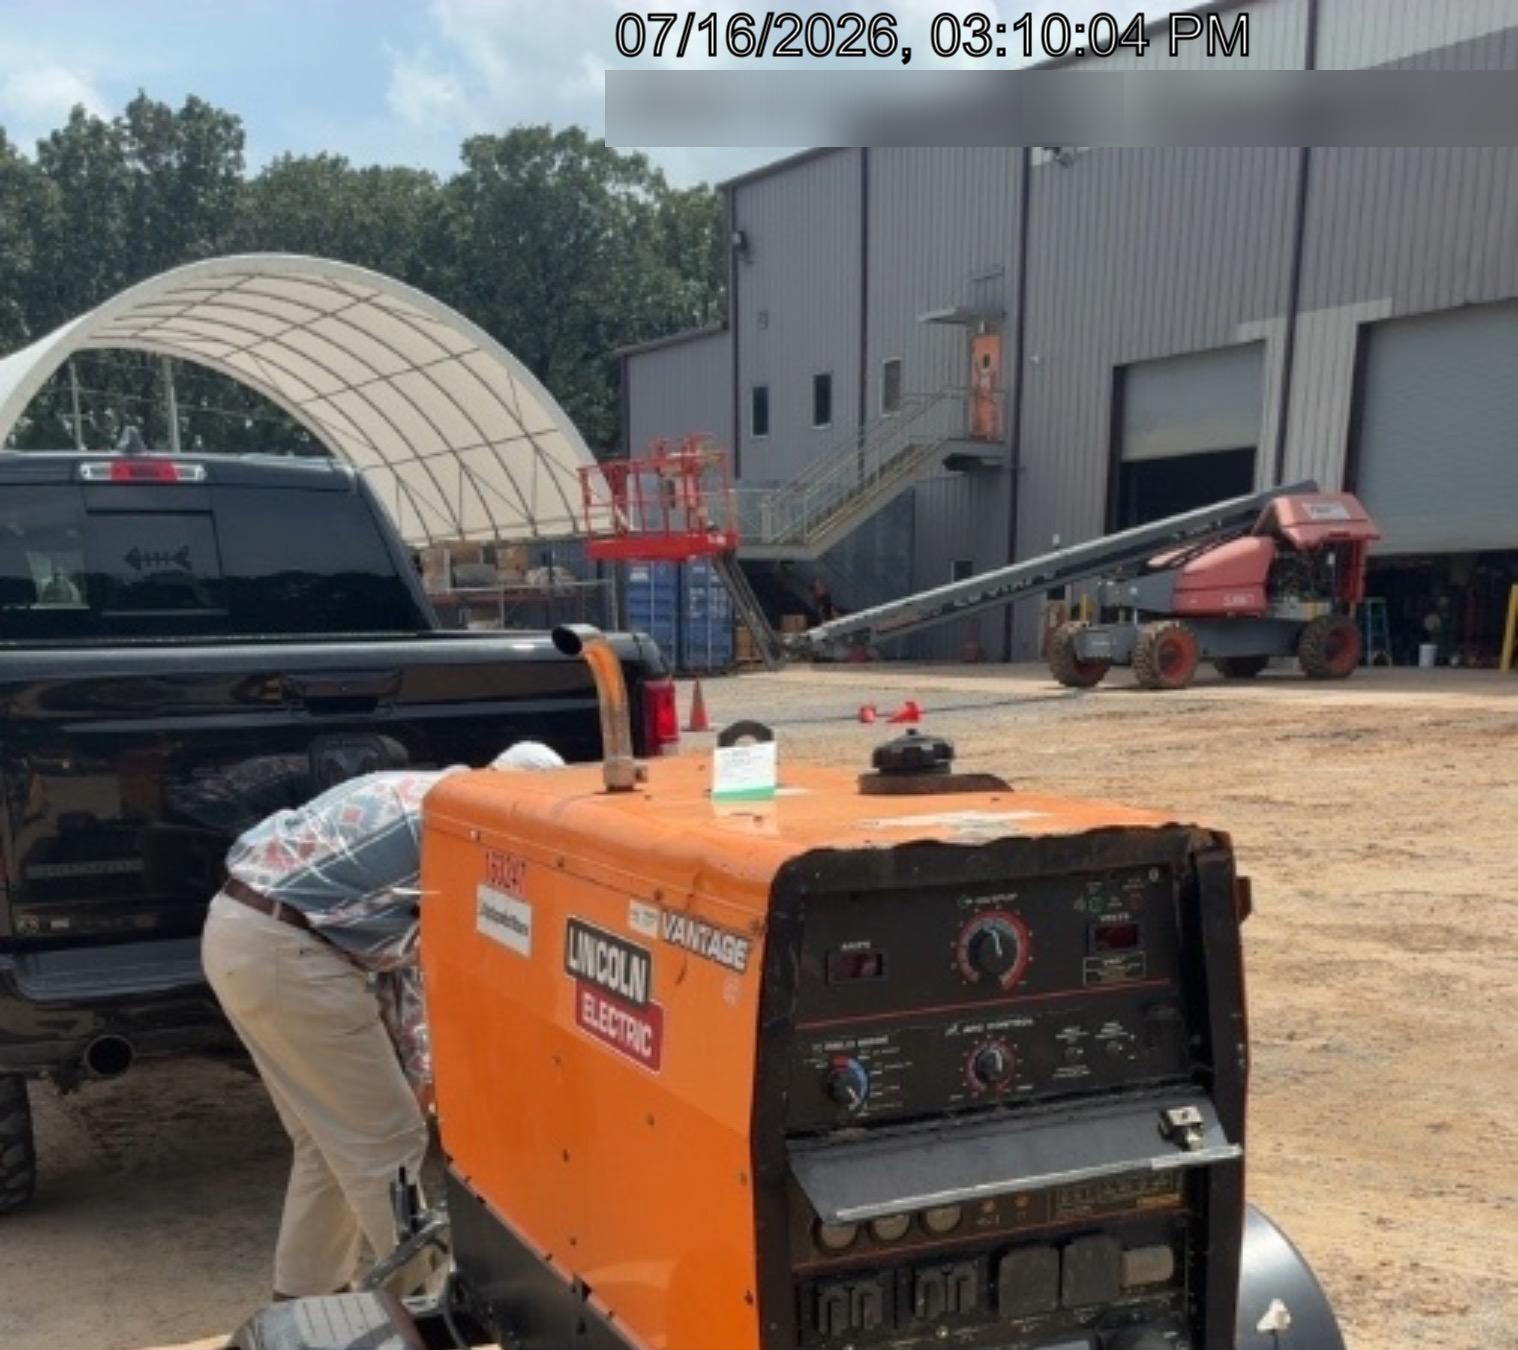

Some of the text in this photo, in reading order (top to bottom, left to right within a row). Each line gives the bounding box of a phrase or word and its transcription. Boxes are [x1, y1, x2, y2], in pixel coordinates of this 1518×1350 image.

[569, 926, 647, 1003] LINCOLN
[661, 911, 749, 970] VANTAGE
[582, 992, 653, 1058] ELECTRIC
